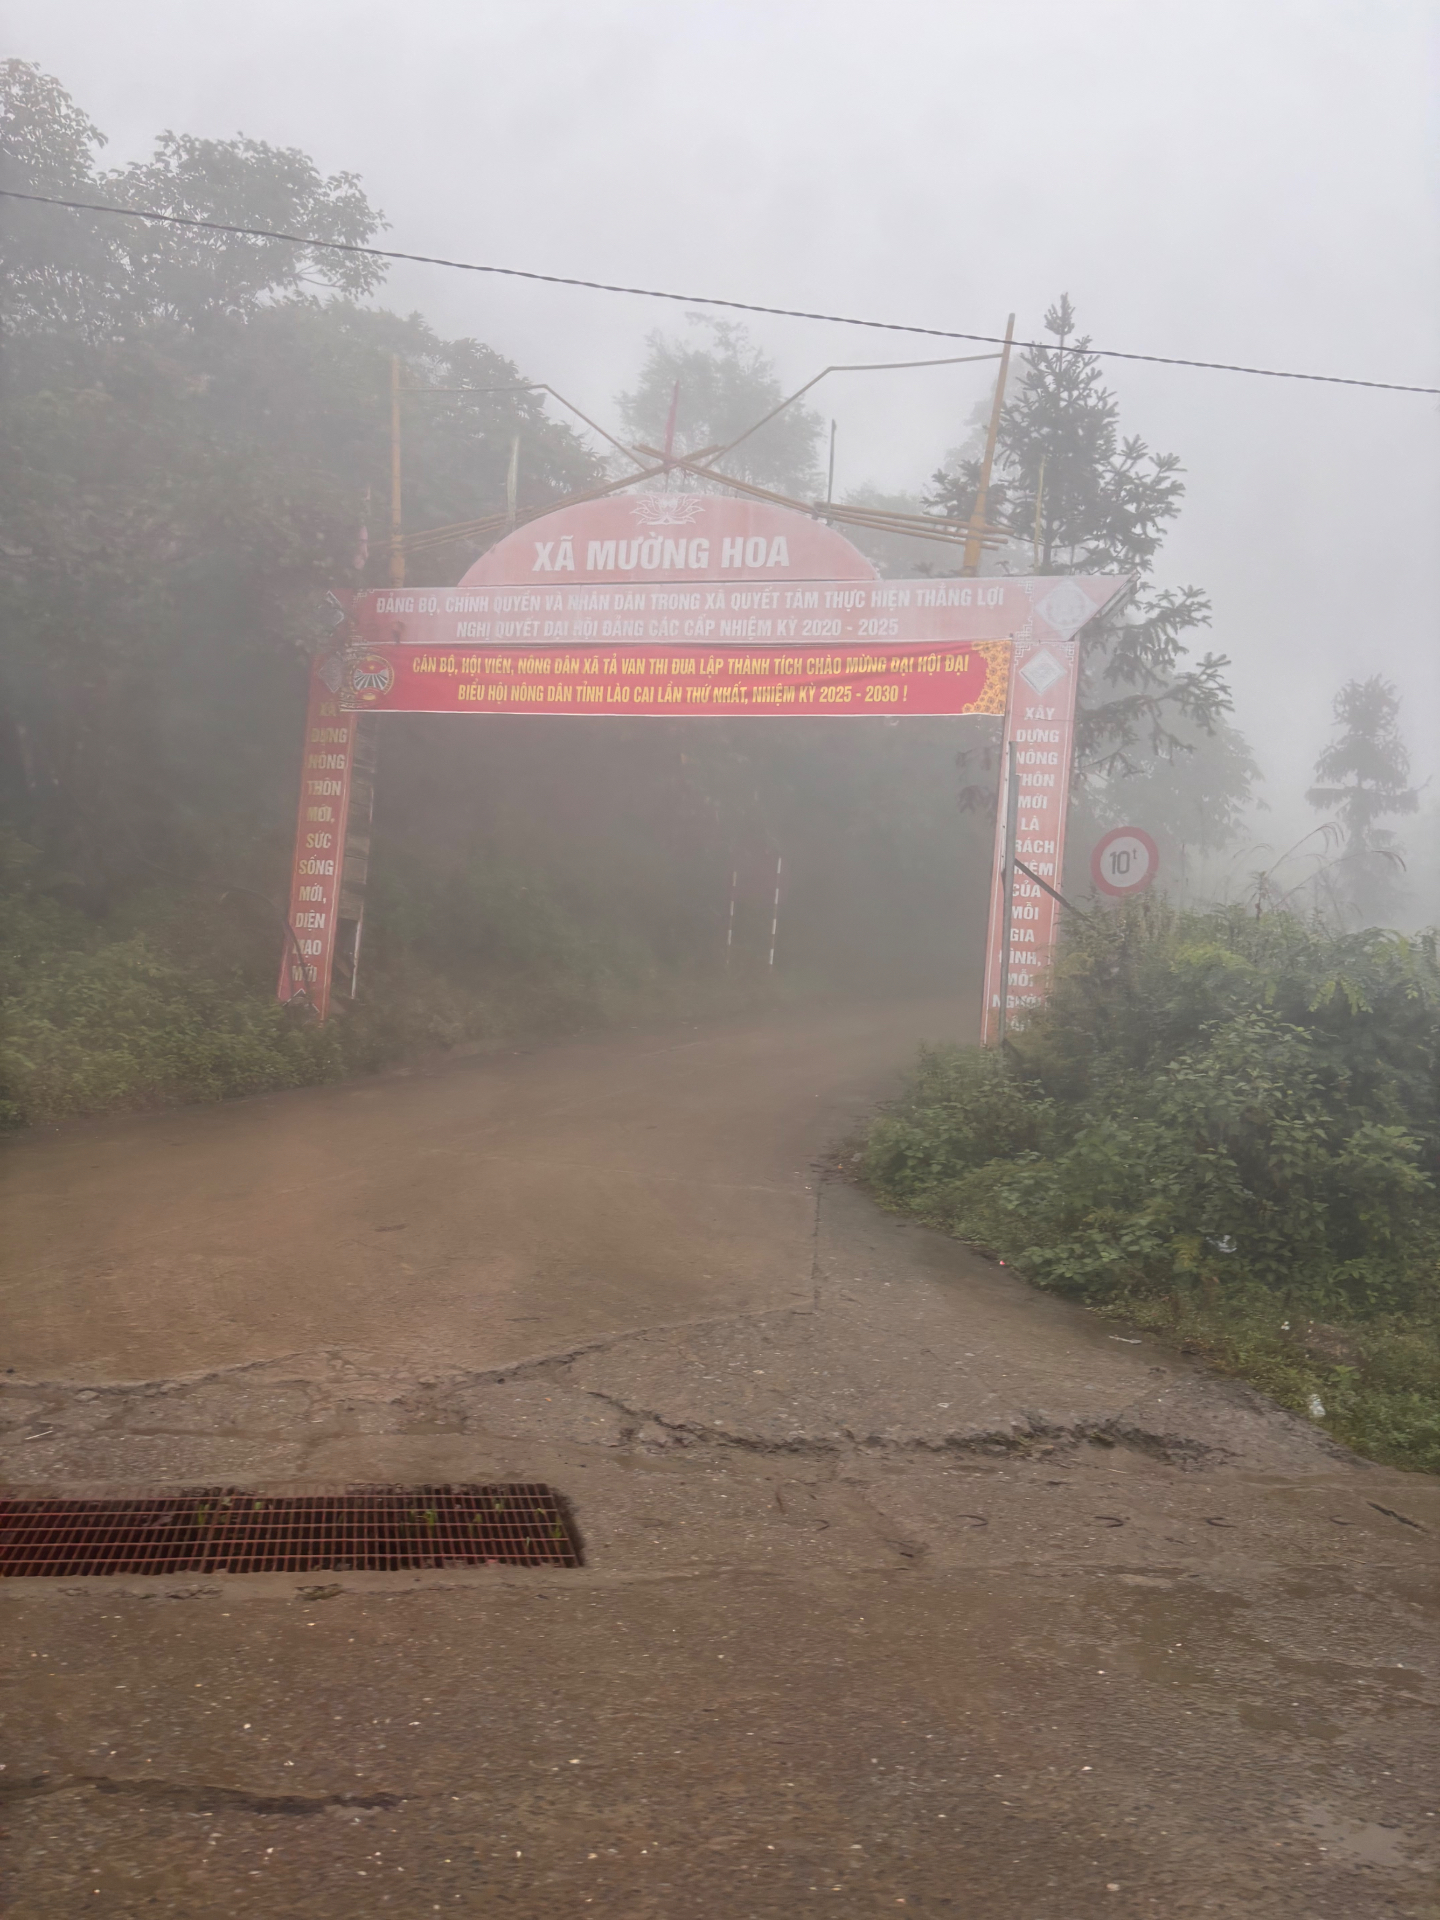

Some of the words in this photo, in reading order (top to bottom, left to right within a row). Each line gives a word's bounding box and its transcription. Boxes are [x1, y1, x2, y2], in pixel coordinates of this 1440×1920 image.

[532, 535, 575, 571] XÃ
[586, 532, 709, 571] MƯỜNG
[721, 536, 790, 568] HOA
[376, 592, 414, 613] ĐẢNG
[445, 593, 489, 613] CHÍNH
[493, 589, 541, 614] QUYỀN
[545, 592, 563, 611] VÀ
[567, 591, 610, 611] NHÂN
[614, 590, 646, 611] DÂN
[651, 593, 701, 610] TRONG
[704, 589, 726, 610] XÃ
[731, 586, 780, 611] QUYẾT
[785, 588, 819, 609] TÂM
[824, 588, 866, 612] THỰC
[871, 587, 910, 612] HIỆN
[977, 586, 1005, 611] LỢI
[456, 621, 491, 641] NGHỊ
[495, 616, 541, 639] QUYẾT
[573, 617, 598, 640] HỘI
[602, 614, 645, 637] ĐẢNG
[649, 616, 679, 637] CÁC
[684, 613, 716, 637] CẤP
[719, 616, 773, 640] NHIỆM
[802, 618, 842, 636] 2020
[857, 618, 899, 636] 2025
[413, 654, 437, 674] CÁN
[439, 655, 458, 676] BỘ,
[462, 655, 481, 677] HỘI
[484, 655, 514, 676] VIÊN,
[518, 655, 551, 675] NÔNG
[554, 655, 580, 675] DÂN
[583, 655, 599, 675] XÃ
[603, 653, 618, 675] TẢ
[621, 658, 646, 675] VAN
[649, 658, 669, 675] THI
[671, 658, 696, 675] ĐUA
[699, 655, 724, 679] LẬP
[728, 655, 770, 675] THÀNH
[774, 655, 803, 675] TÍCH
[806, 654, 842, 675] CHÀO
[846, 653, 887, 673] MỪNG
[890, 657, 914, 677] ĐẠI
[917, 653, 942, 676] HỘI
[945, 654, 970, 676] ĐẠI
[458, 678, 486, 701] BIỂU
[488, 682, 508, 704] HỘI
[510, 682, 544, 702] NÔNG
[547, 682, 573, 702] DÂN
[576, 680, 604, 702] TỈNH
[607, 683, 630, 703] LÀO
[633, 686, 655, 703] CAI
[657, 681, 683, 703] LẦN
[686, 683, 712, 703] THỨ
[713, 681, 749, 705] NHẤT,
[752, 683, 796, 707] NHIỆM
[798, 683, 816, 703] KỲ
[819, 686, 853, 703] 2025
[865, 685, 899, 703] 2030
[903, 685, 908, 703] !
[1024, 704, 1056, 721] XÂY
[1016, 728, 1060, 745] DỰNG
[307, 751, 346, 769] NÔNG
[1016, 749, 1059, 766] NÔNG
[307, 777, 342, 796] THÔN
[1018, 792, 1048, 809] MỚI
[1021, 815, 1040, 831] LÀ
[306, 830, 332, 849] SỨC
[298, 854, 334, 876] SỐNG
[298, 883, 327, 904] MỚI,
[295, 909, 326, 931] DIỆN
[1010, 928, 1035, 942] GIA
